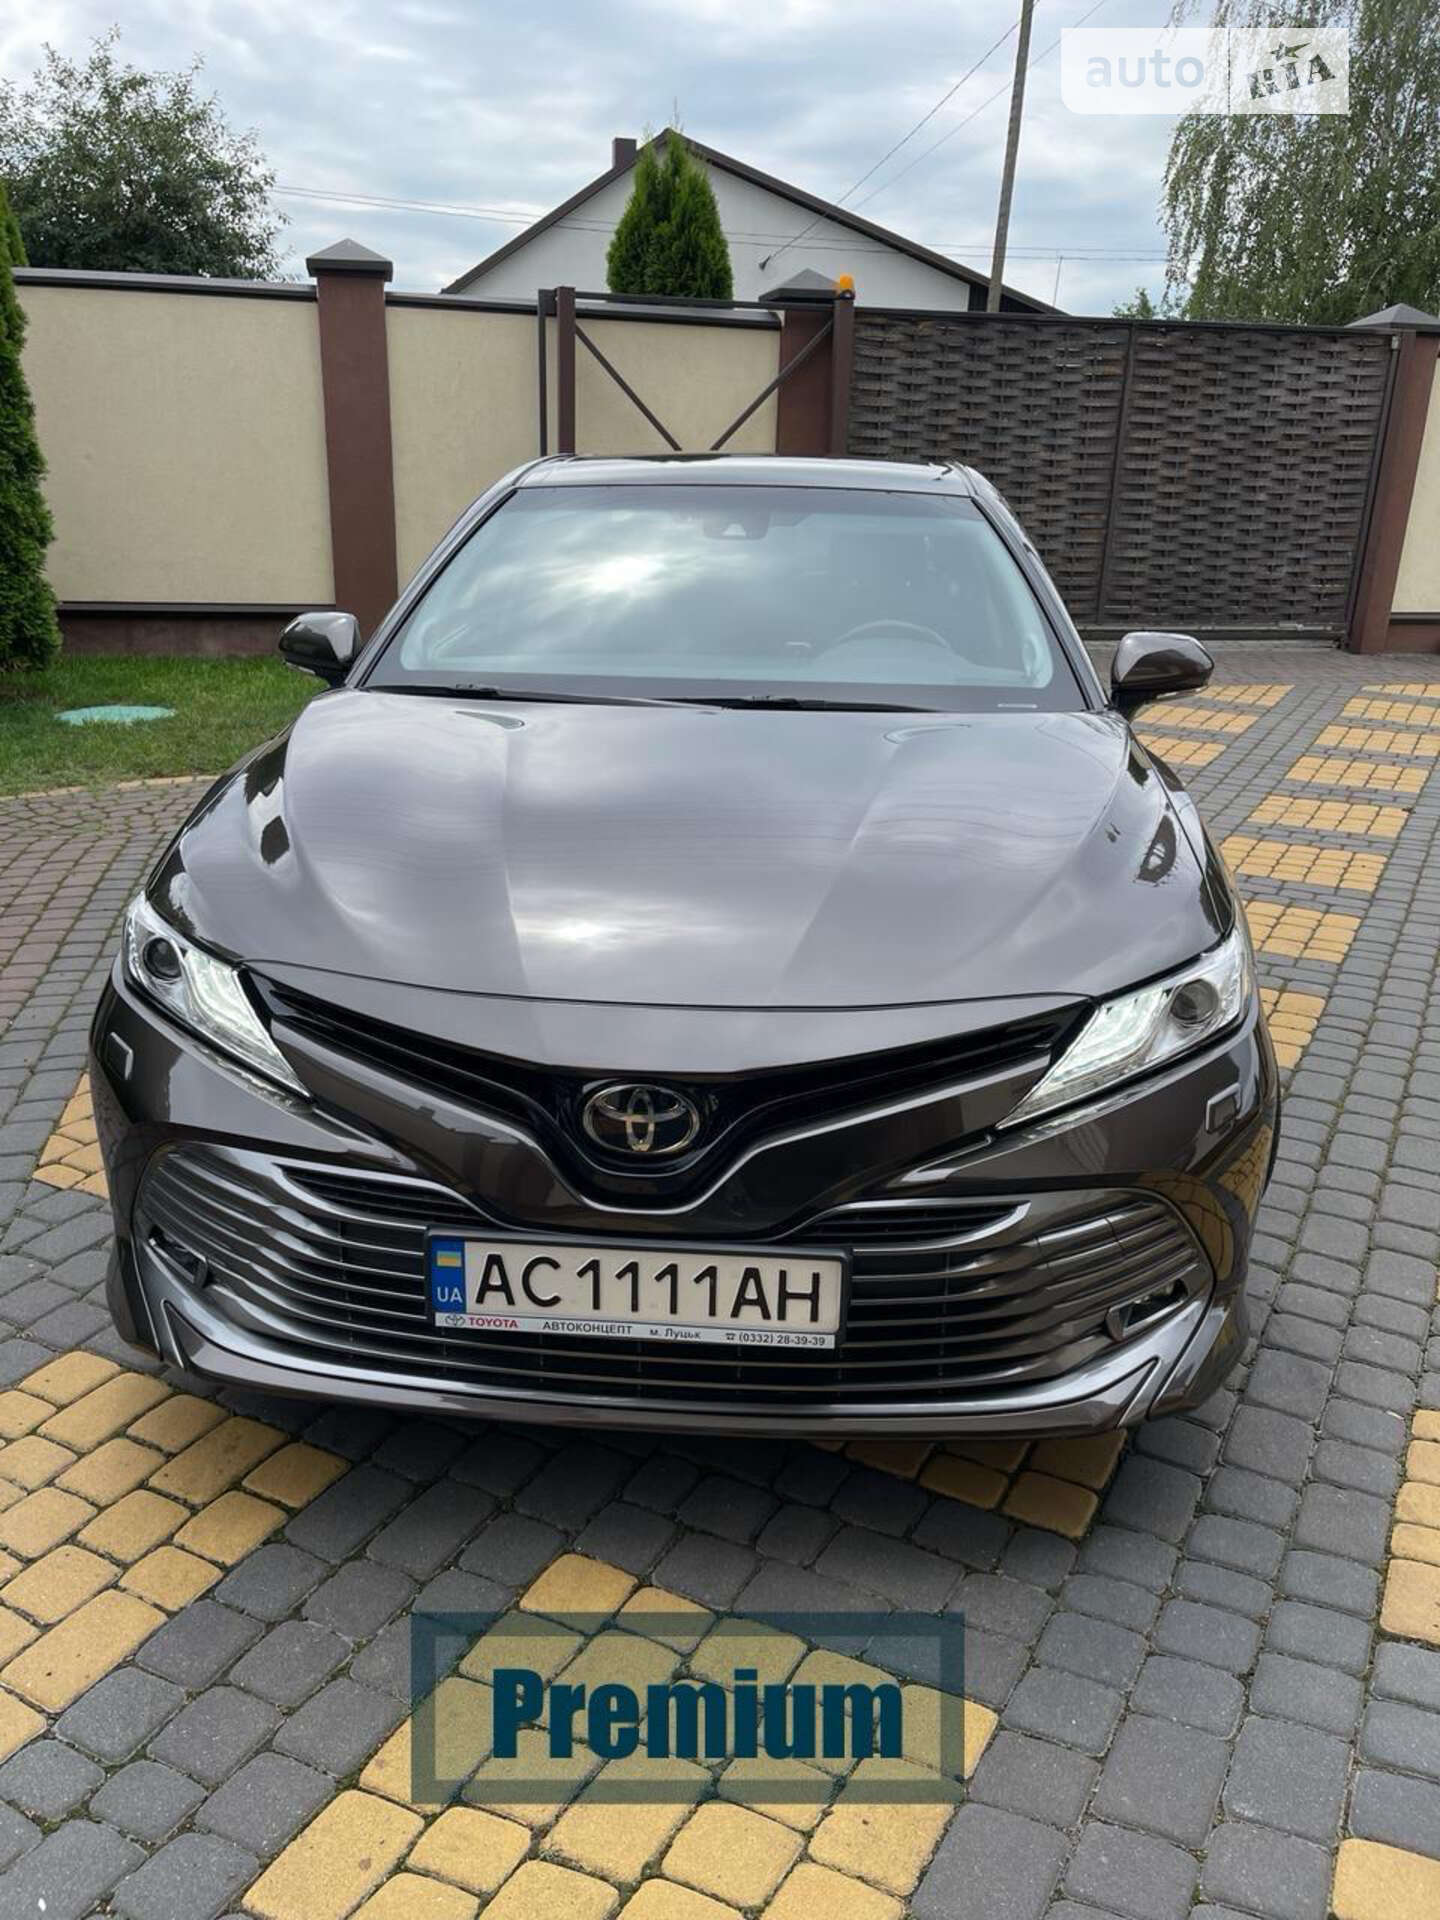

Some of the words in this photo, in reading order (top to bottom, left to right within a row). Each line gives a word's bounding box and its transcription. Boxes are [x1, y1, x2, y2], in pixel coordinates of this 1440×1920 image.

[437, 1286, 463, 1303] UA
[475, 1253, 820, 1323] AC1111AH
[468, 1317, 518, 1329] TOYOTA
[542, 1320, 633, 1336] АВТОКОНЦЕПТ
[738, 1331, 775, 1345] (0332)
[776, 1333, 827, 1347] 28-39-39
